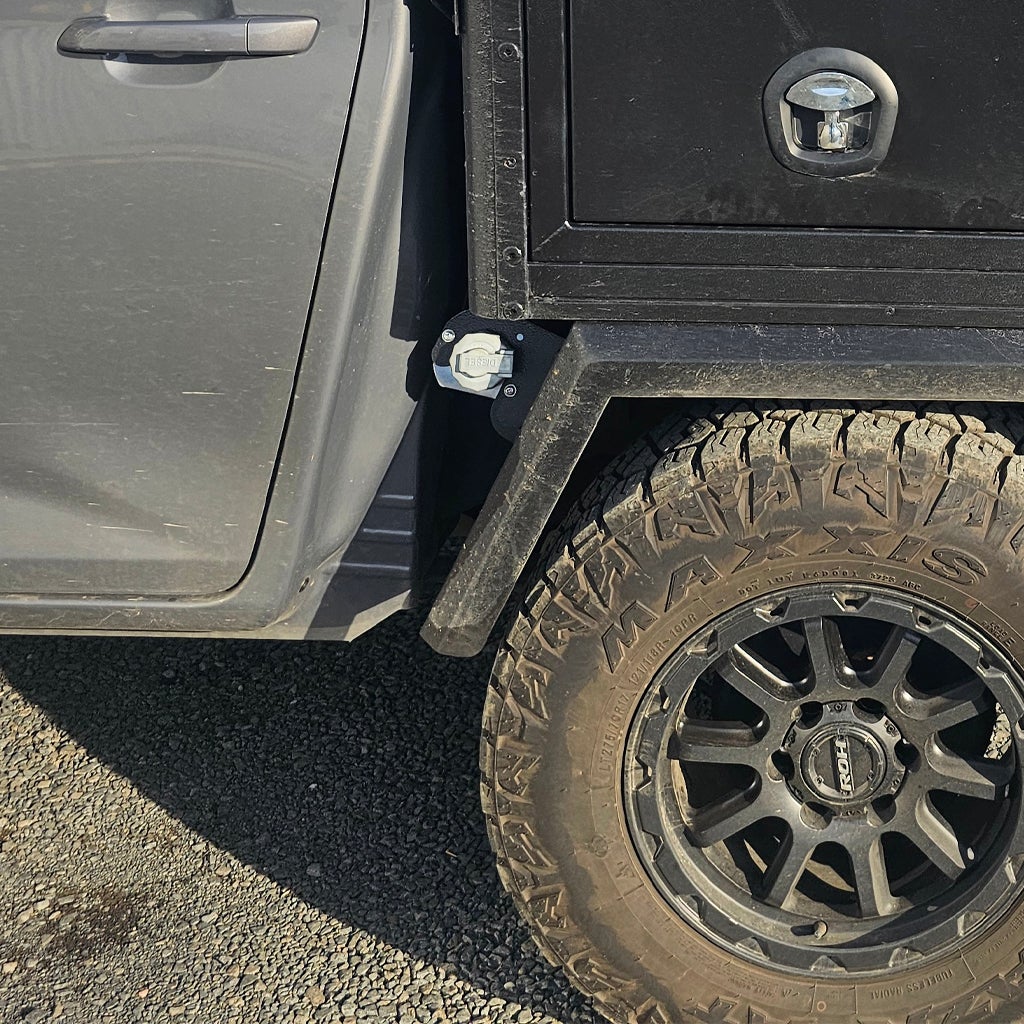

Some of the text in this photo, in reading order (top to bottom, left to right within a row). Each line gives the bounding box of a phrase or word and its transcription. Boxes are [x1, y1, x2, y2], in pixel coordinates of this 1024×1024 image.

[465, 357, 498, 367] DIESEL
[601, 525, 990, 674] MAXXIS
[834, 737, 853, 792] ROH
